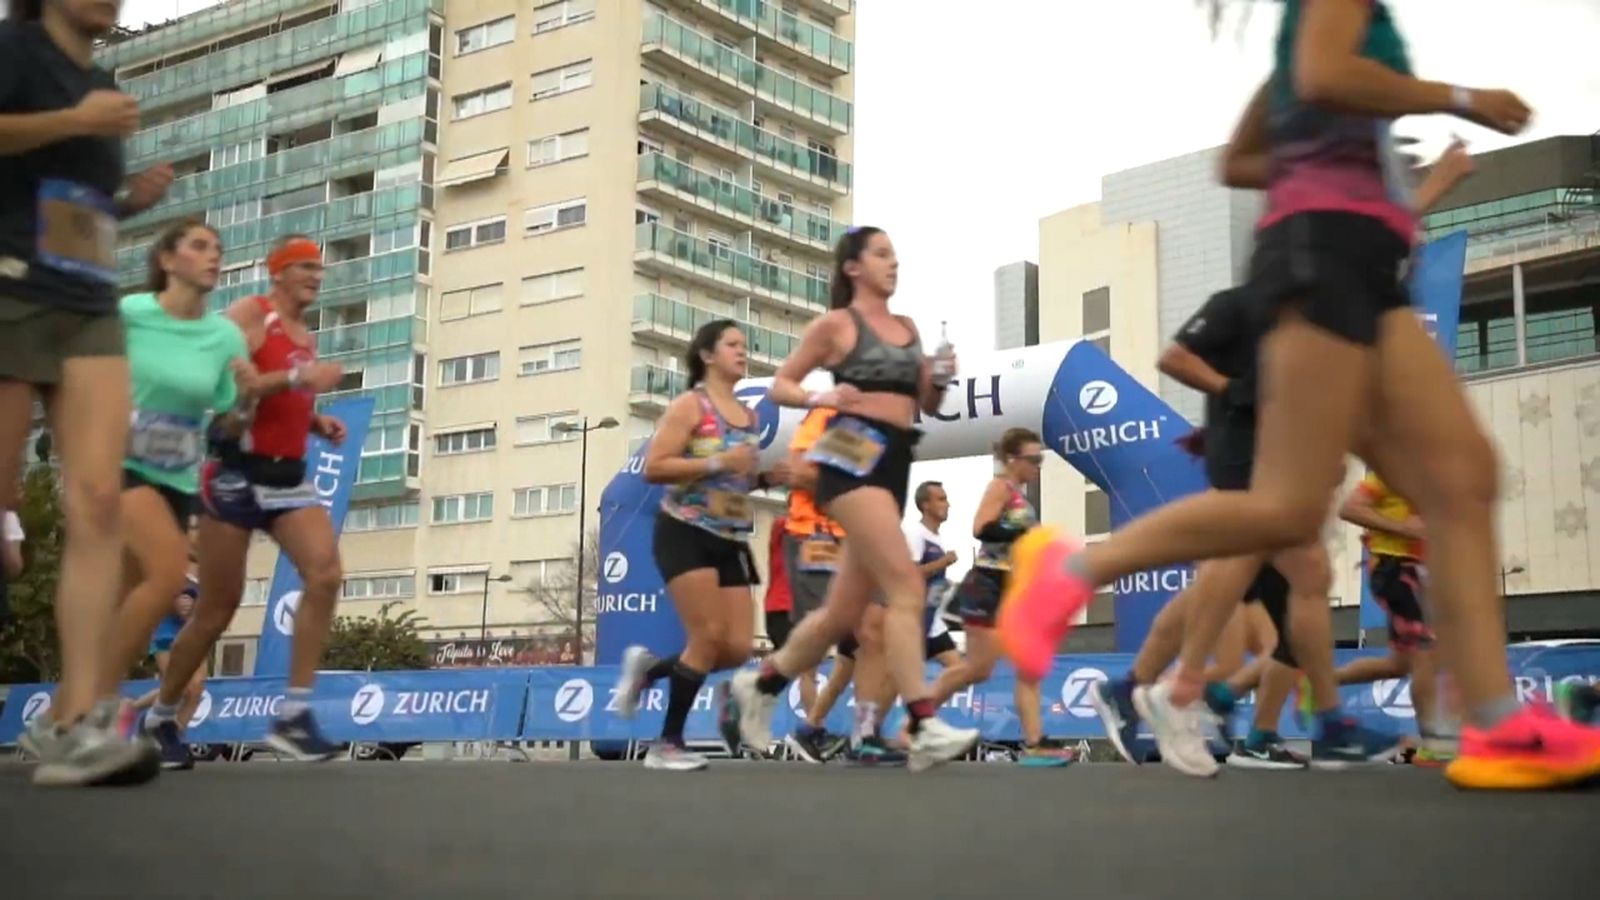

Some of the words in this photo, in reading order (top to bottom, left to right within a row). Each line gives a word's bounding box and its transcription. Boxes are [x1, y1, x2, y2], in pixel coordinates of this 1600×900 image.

[1059, 420, 1161, 455] ZURICH
[596, 593, 657, 613] URICH
[218, 695, 285, 718] ZURIC
[393, 689, 489, 714] ZURICH
[604, 687, 714, 711] ZRH
